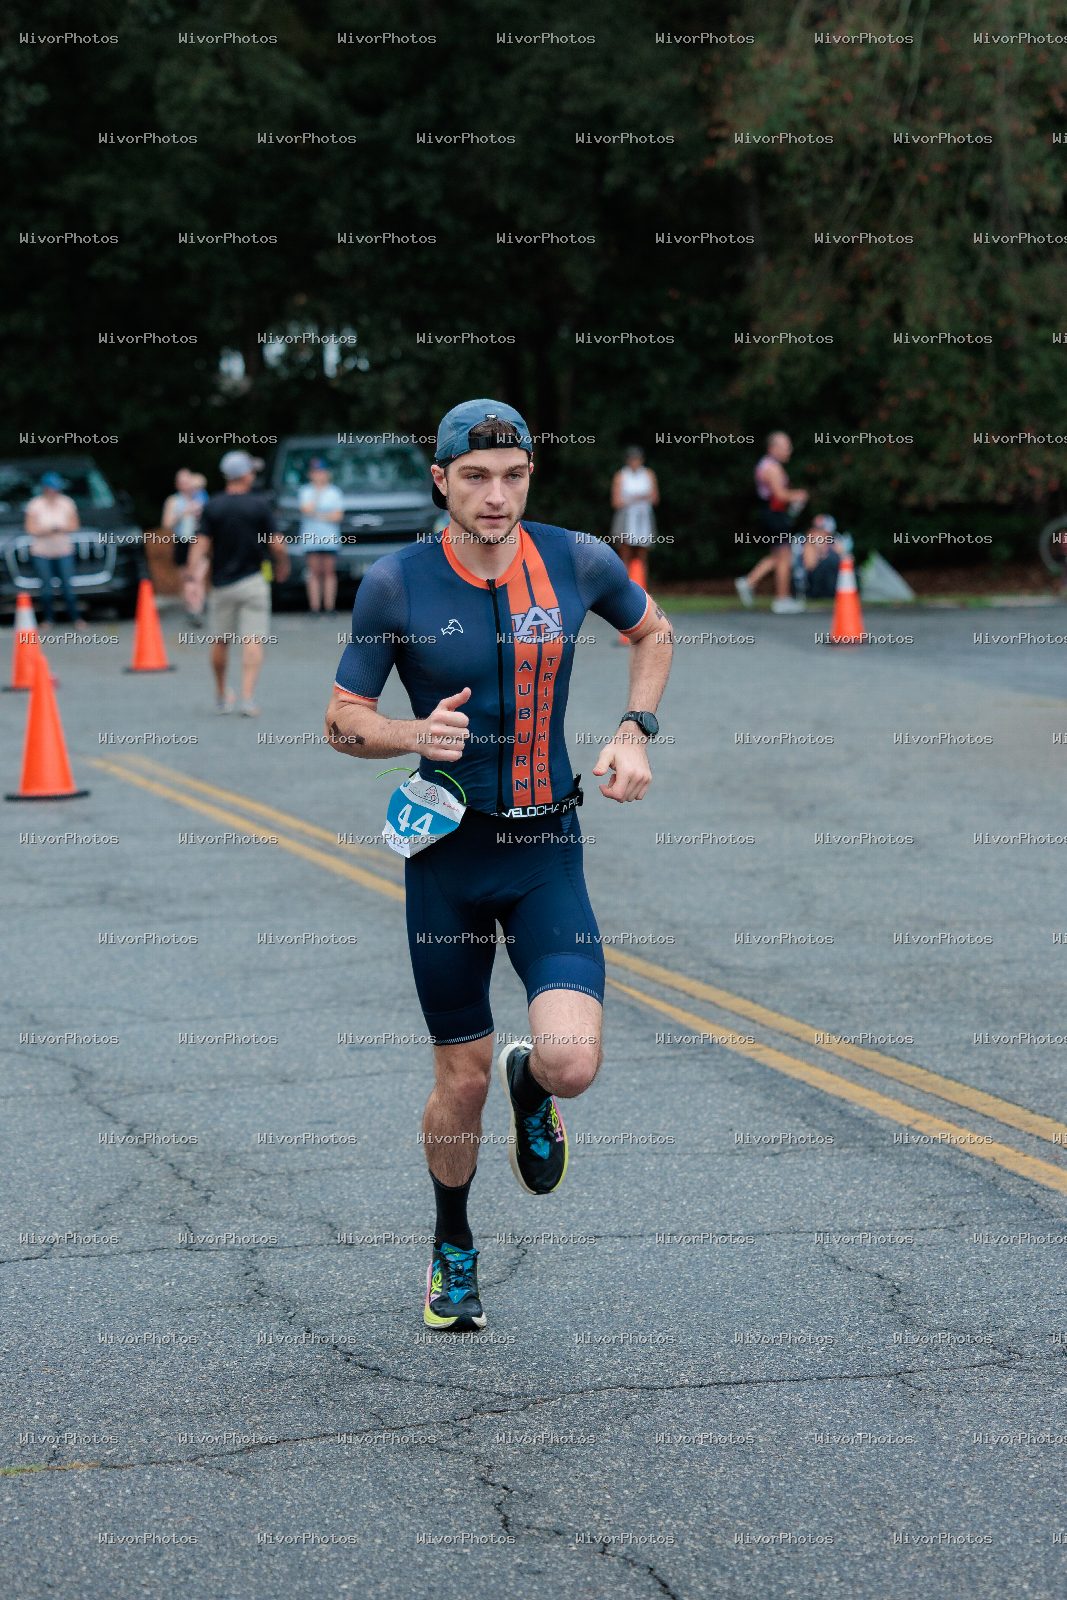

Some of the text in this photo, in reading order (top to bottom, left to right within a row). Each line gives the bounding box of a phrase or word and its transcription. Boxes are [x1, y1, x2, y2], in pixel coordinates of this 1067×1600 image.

[514, 659, 533, 792] AUBURN
[536, 656, 558, 789] TRIATHLON
[398, 803, 434, 836] 44
